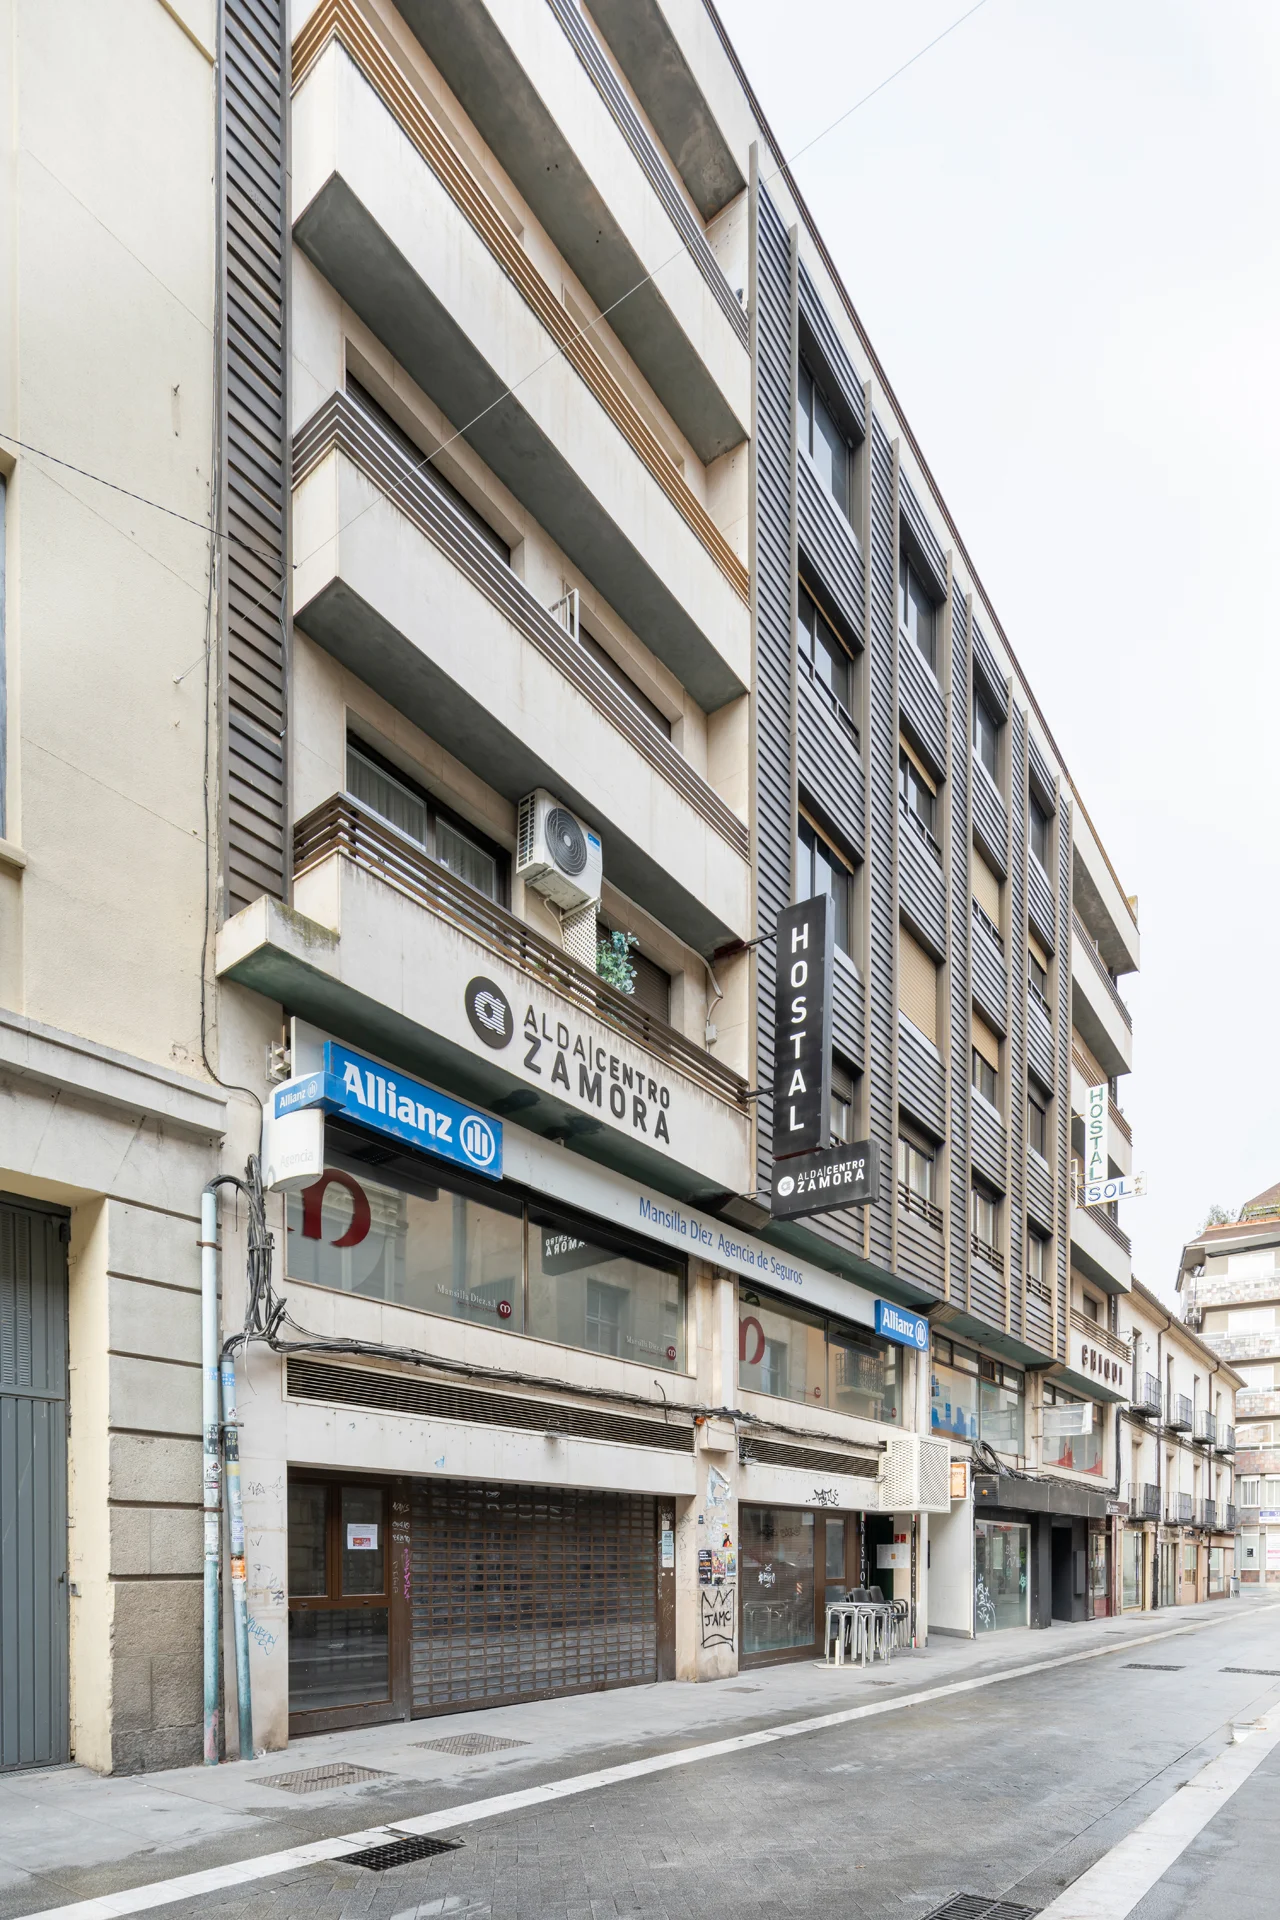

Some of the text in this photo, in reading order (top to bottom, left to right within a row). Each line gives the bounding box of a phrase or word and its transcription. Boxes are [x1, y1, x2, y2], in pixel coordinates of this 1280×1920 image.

[788, 923, 809, 1132] HOSTAL
[280, 1089, 307, 1109] Allianz
[343, 1060, 453, 1143] Allianz
[523, 1031, 670, 1145] ZAMORA
[1089, 1087, 1104, 1181] HOSTAL
[280, 1149, 314, 1168] Agencia
[796, 1168, 865, 1194] ZAMORA
[1088, 1181, 1132, 1202] SOL
[639, 1196, 687, 1236] Mansilla
[717, 1233, 755, 1265] Agencia
[757, 1250, 769, 1271] de
[770, 1256, 803, 1285] Seguros
[437, 1283, 469, 1301] Mansilla
[882, 1307, 914, 1338] Allianz
[1081, 1344, 1123, 1386] CHIQUI
